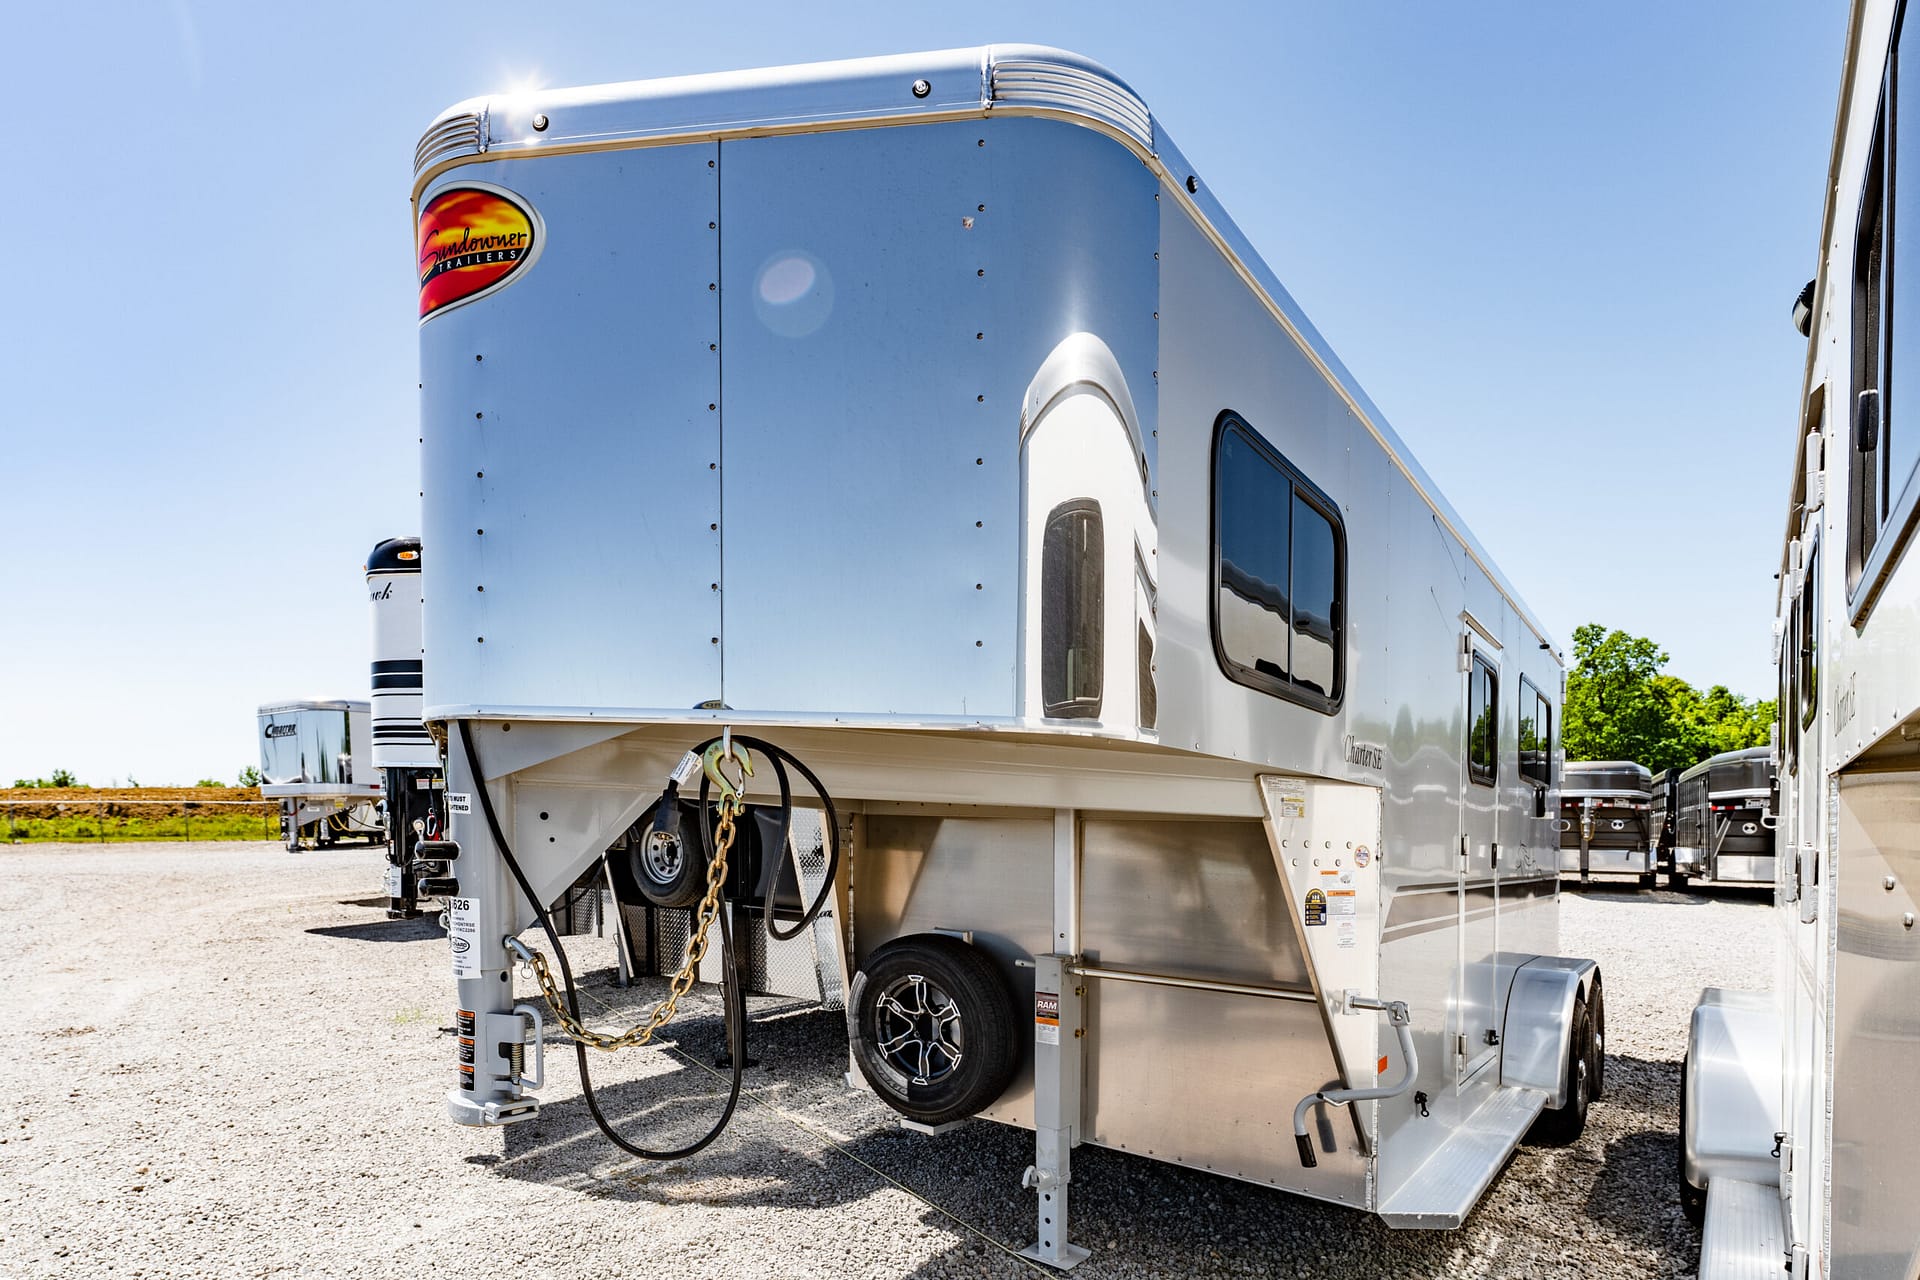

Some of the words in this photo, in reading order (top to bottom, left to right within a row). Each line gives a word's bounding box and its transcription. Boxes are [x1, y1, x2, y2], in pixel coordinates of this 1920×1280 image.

[420, 226, 527, 267] Sundowner
[439, 250, 516, 273] TRAILERS
[1344, 734, 1372, 767] Charter
[1373, 748, 1382, 769] SE
[1037, 1000, 1057, 1010] RAM
